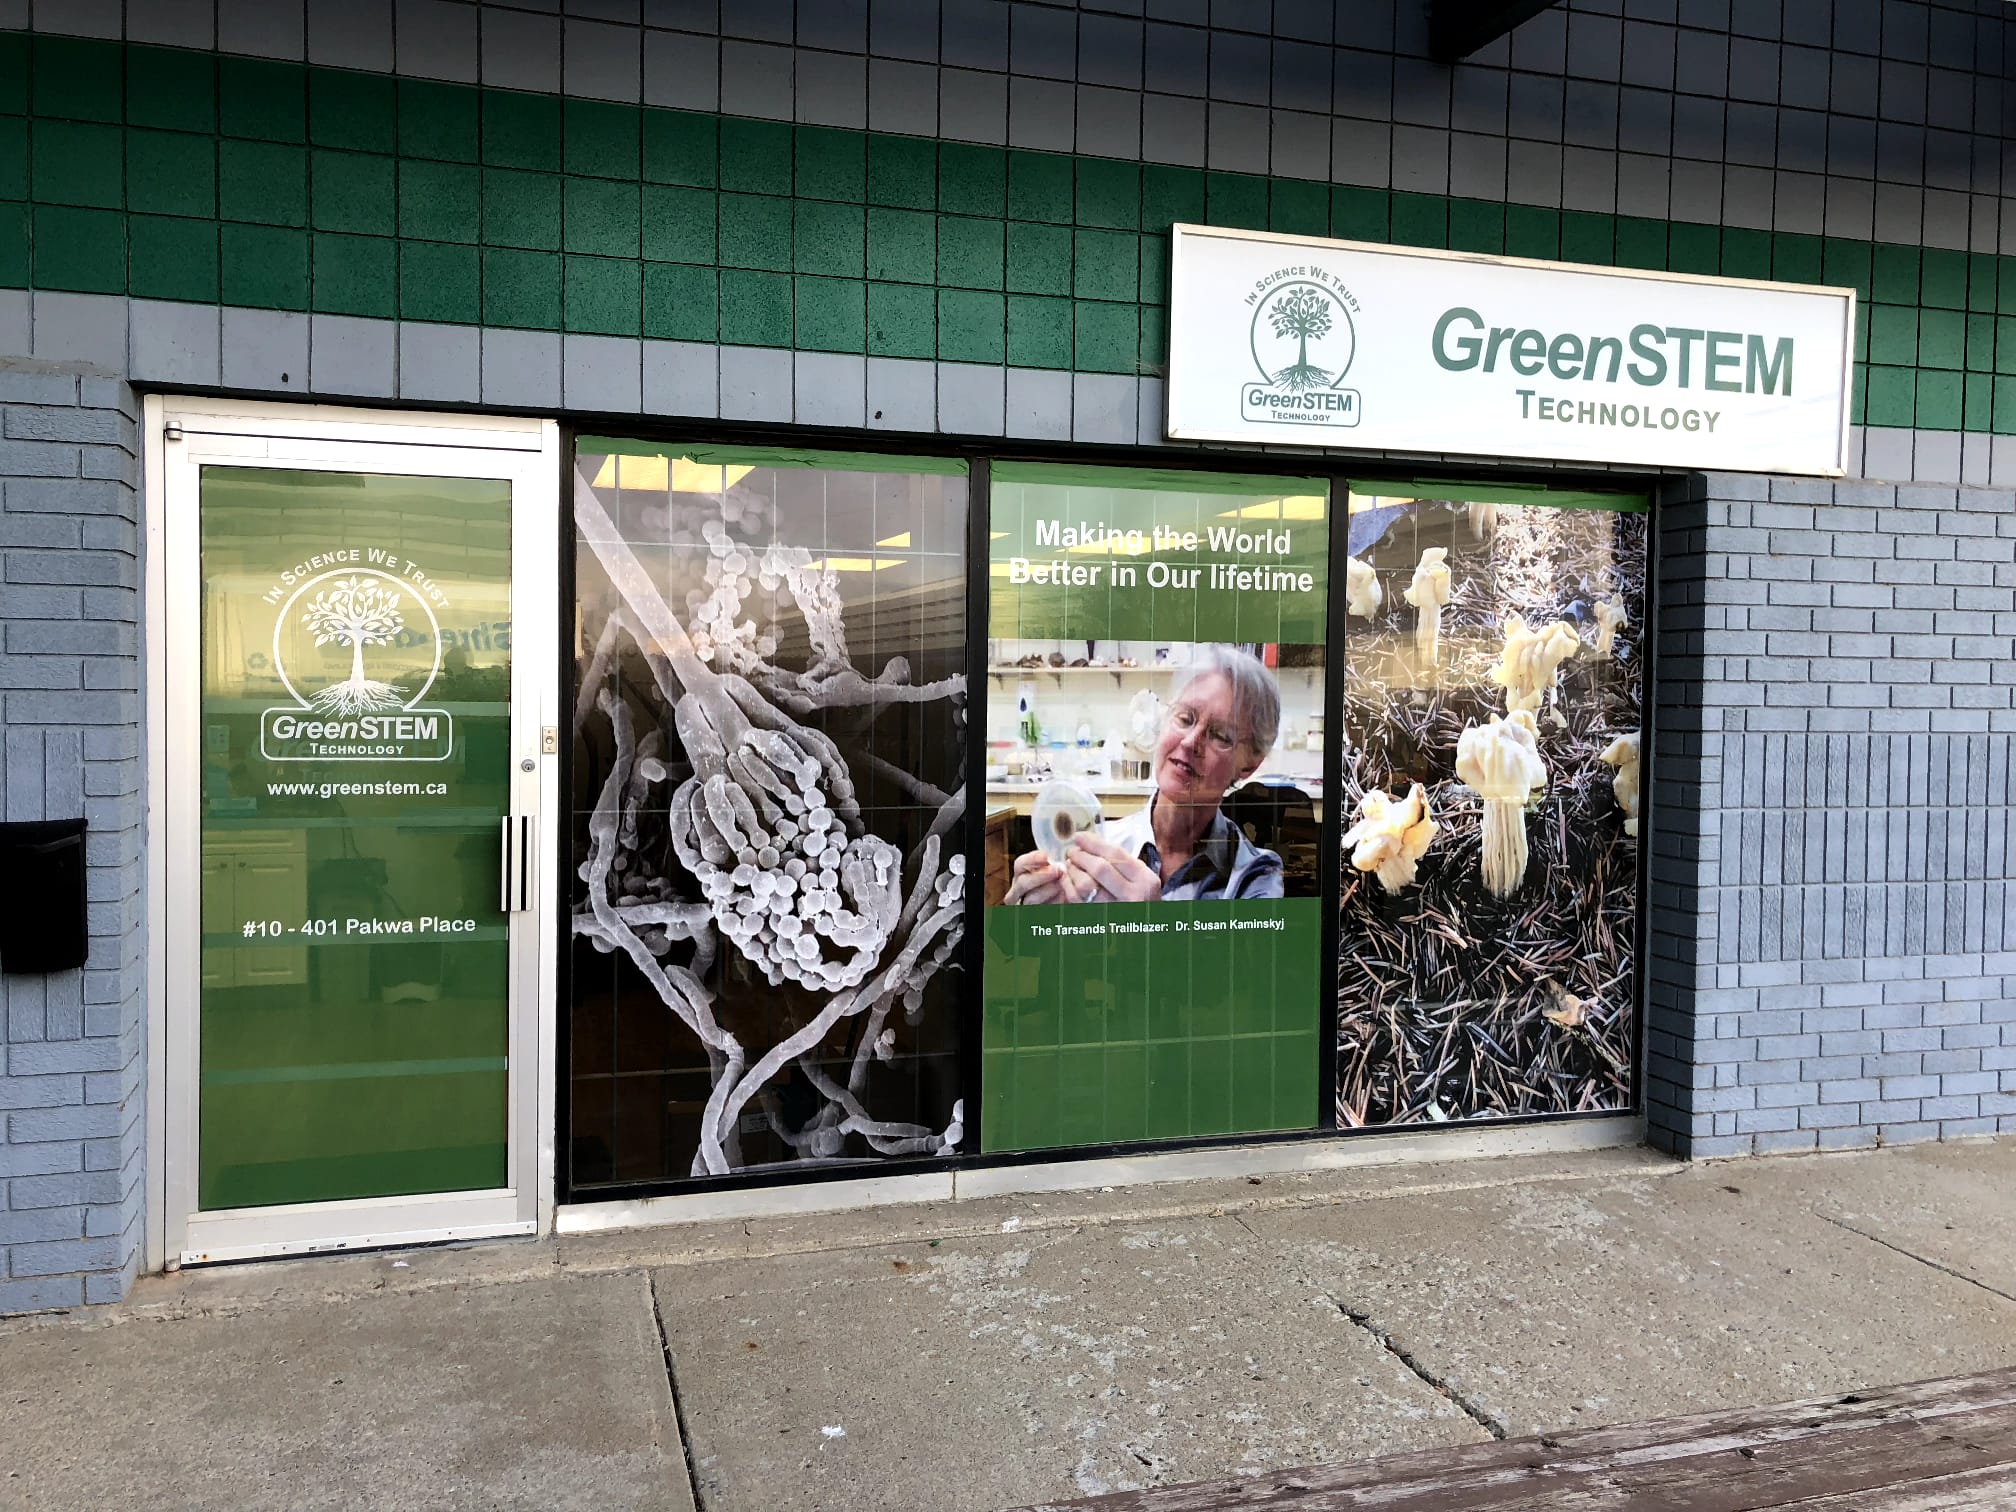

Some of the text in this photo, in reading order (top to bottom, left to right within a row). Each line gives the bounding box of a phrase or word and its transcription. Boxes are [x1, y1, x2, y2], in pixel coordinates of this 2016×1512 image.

[1431, 306, 1794, 397] GreenSTEM
[1248, 388, 1353, 412] GreenSTEM
[1516, 389, 1721, 433] TECHNOLOGY
[1272, 411, 1330, 422] TECHNOLOGY
[1035, 519, 1291, 556] Making the World
[1009, 557, 1314, 593] Better in Our lifetime
[272, 715, 438, 740] GreenSTEM
[310, 742, 404, 756] TECHNOLOGY
[267, 780, 448, 799] www.greenstem.ca
[242, 920, 282, 939] #10
[300, 919, 338, 936] 401
[346, 918, 414, 935] Pakwa
[419, 916, 477, 933] Place
[1031, 918, 1285, 936] The Tarsands Trailblazer: Dr. Susan Kaminskyj
